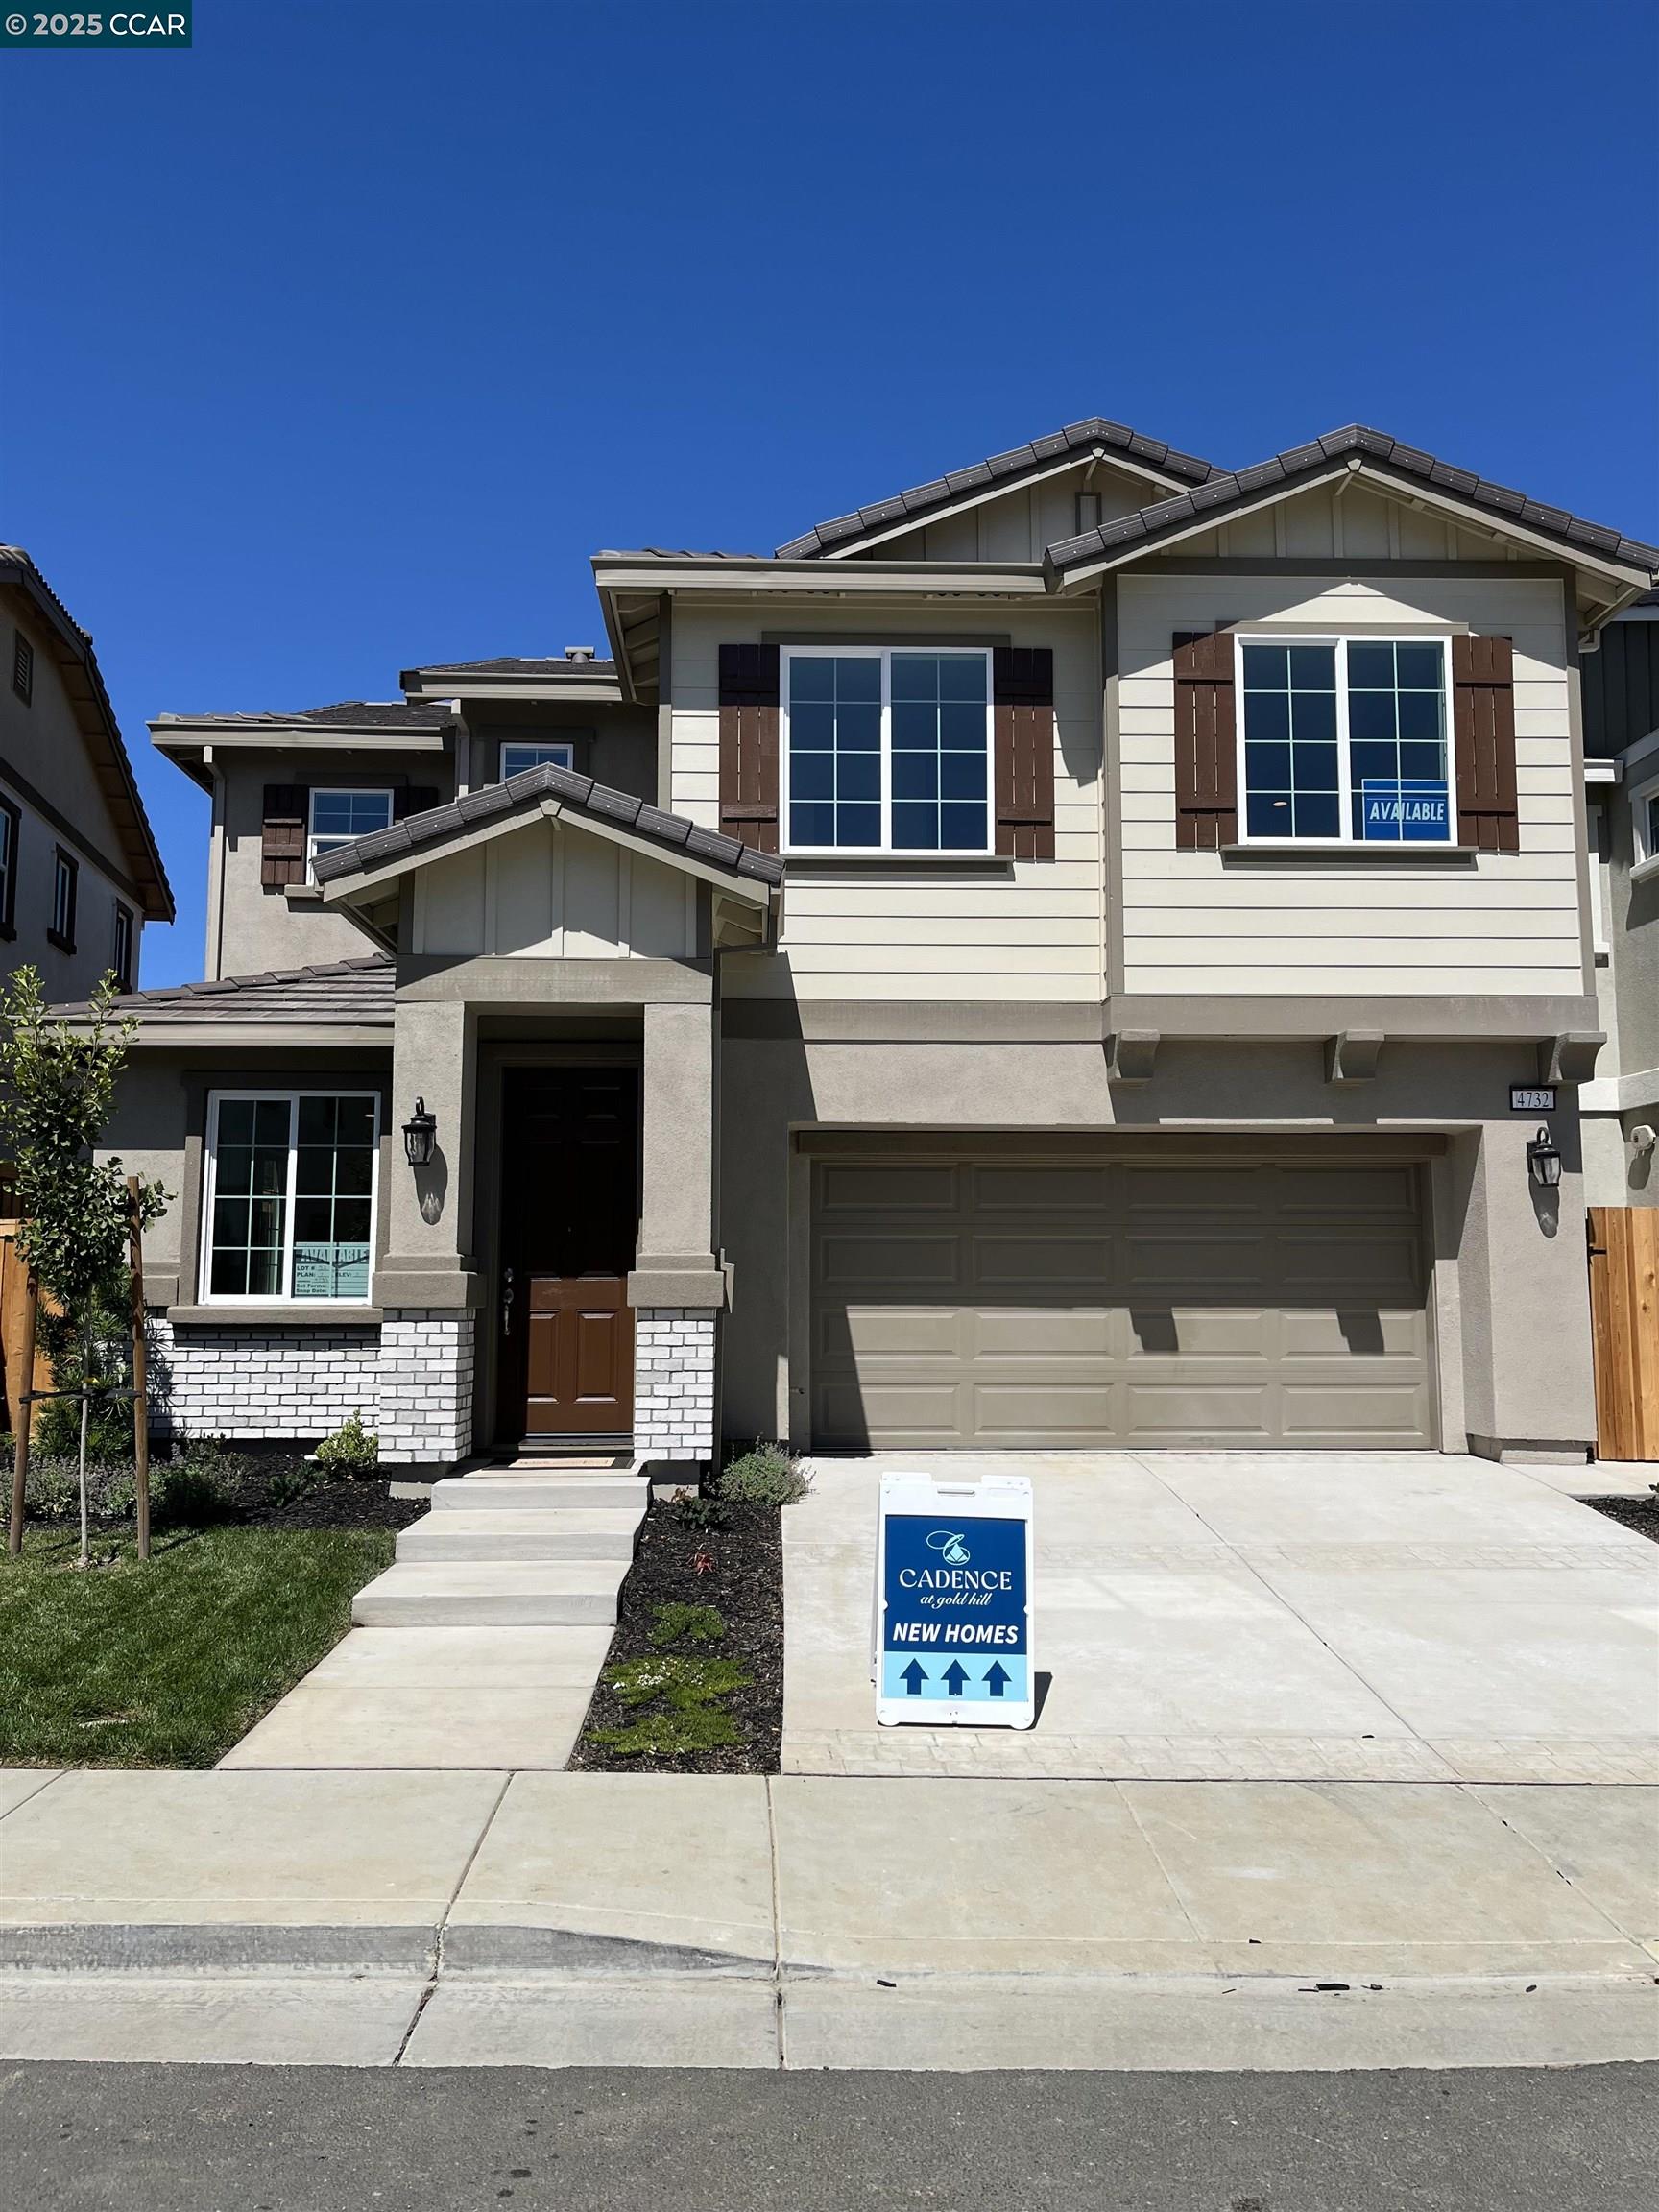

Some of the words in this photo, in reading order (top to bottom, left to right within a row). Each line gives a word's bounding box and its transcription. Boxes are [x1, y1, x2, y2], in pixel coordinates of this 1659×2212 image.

[1369, 801, 1445, 821] AVAILABLE
[1517, 1092, 1550, 1107] 4732
[899, 1568, 1012, 1591] CADENCE
[920, 1595, 934, 1604] at
[931, 1592, 968, 1610] gold
[968, 1592, 993, 1606] hill
[893, 1623, 941, 1642] NEW
[944, 1624, 1019, 1645] HOMES
